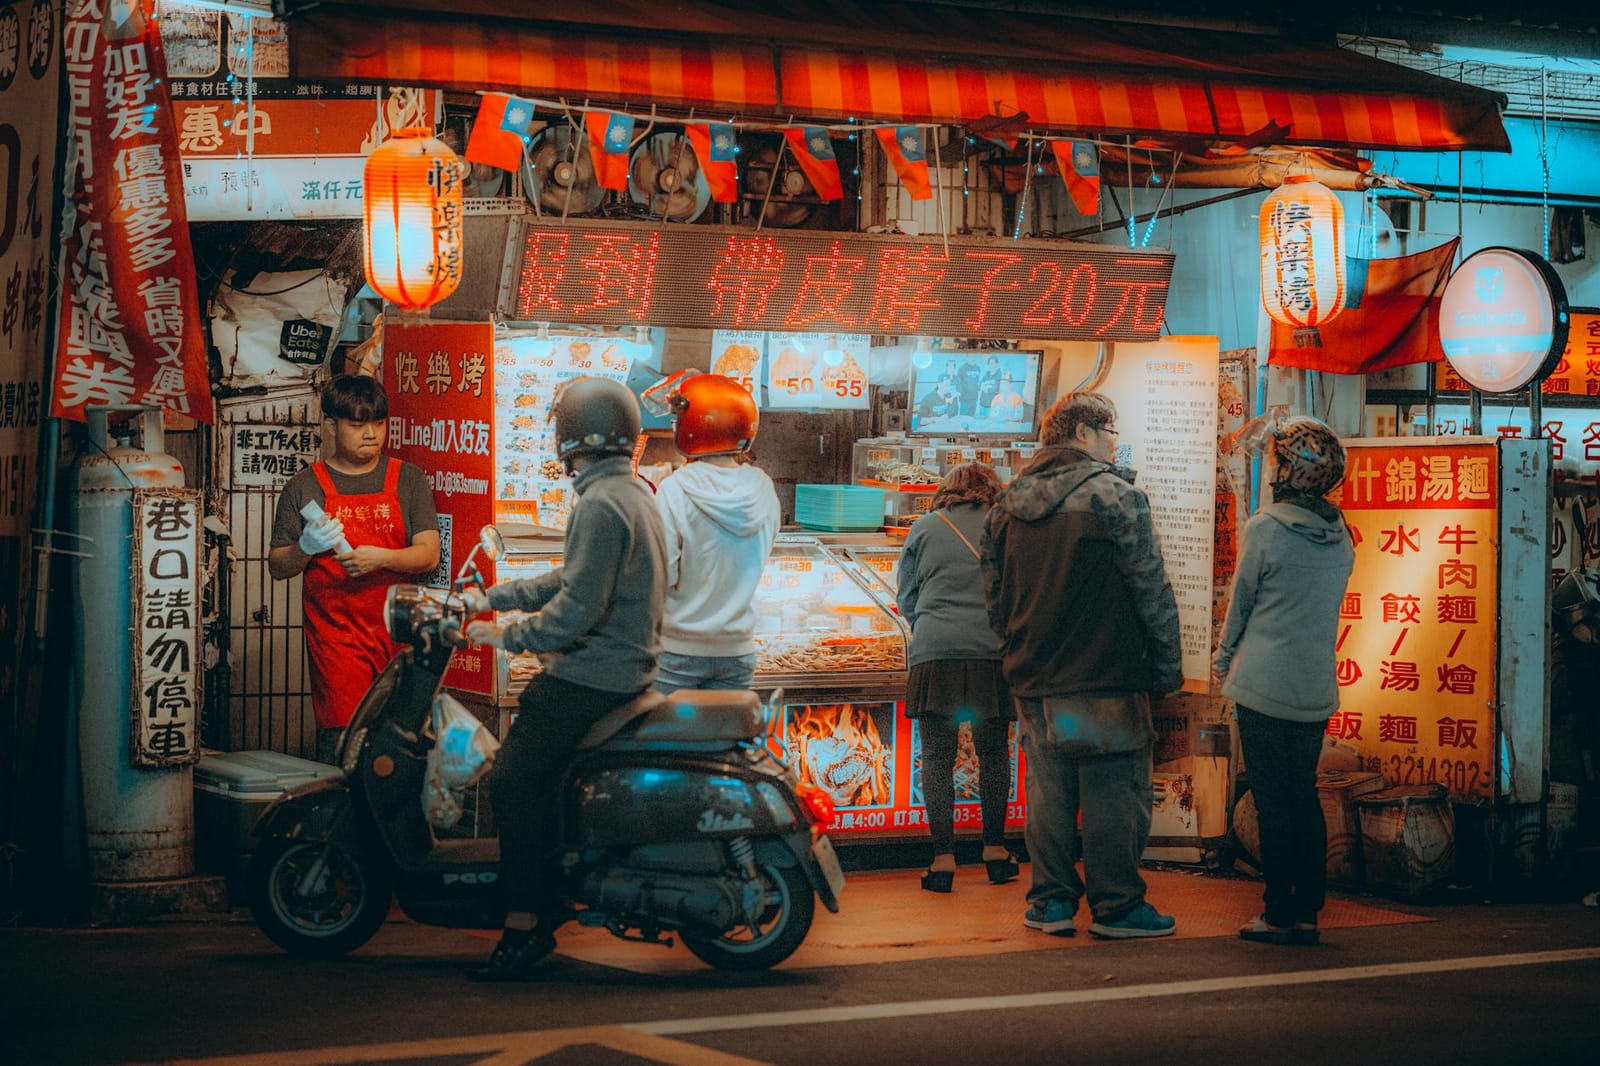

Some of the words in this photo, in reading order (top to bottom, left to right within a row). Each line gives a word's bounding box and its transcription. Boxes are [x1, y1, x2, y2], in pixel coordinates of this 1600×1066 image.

[104, 43, 159, 140] 加好友
[178, 104, 272, 152] 惠中
[113, 144, 177, 273] 優惠多多
[137, 276, 191, 414] 省時又便利
[578, 360, 592, 369] 30
[395, 351, 487, 398] 快樂烤
[786, 377, 814, 395] 50
[835, 379, 862, 398] 55
[1227, 403, 1243, 417] 45
[237, 429, 311, 452] 非工作人員
[1325, 455, 1490, 502] 什錦湯麵
[146, 500, 192, 757] 巷口請勿停車
